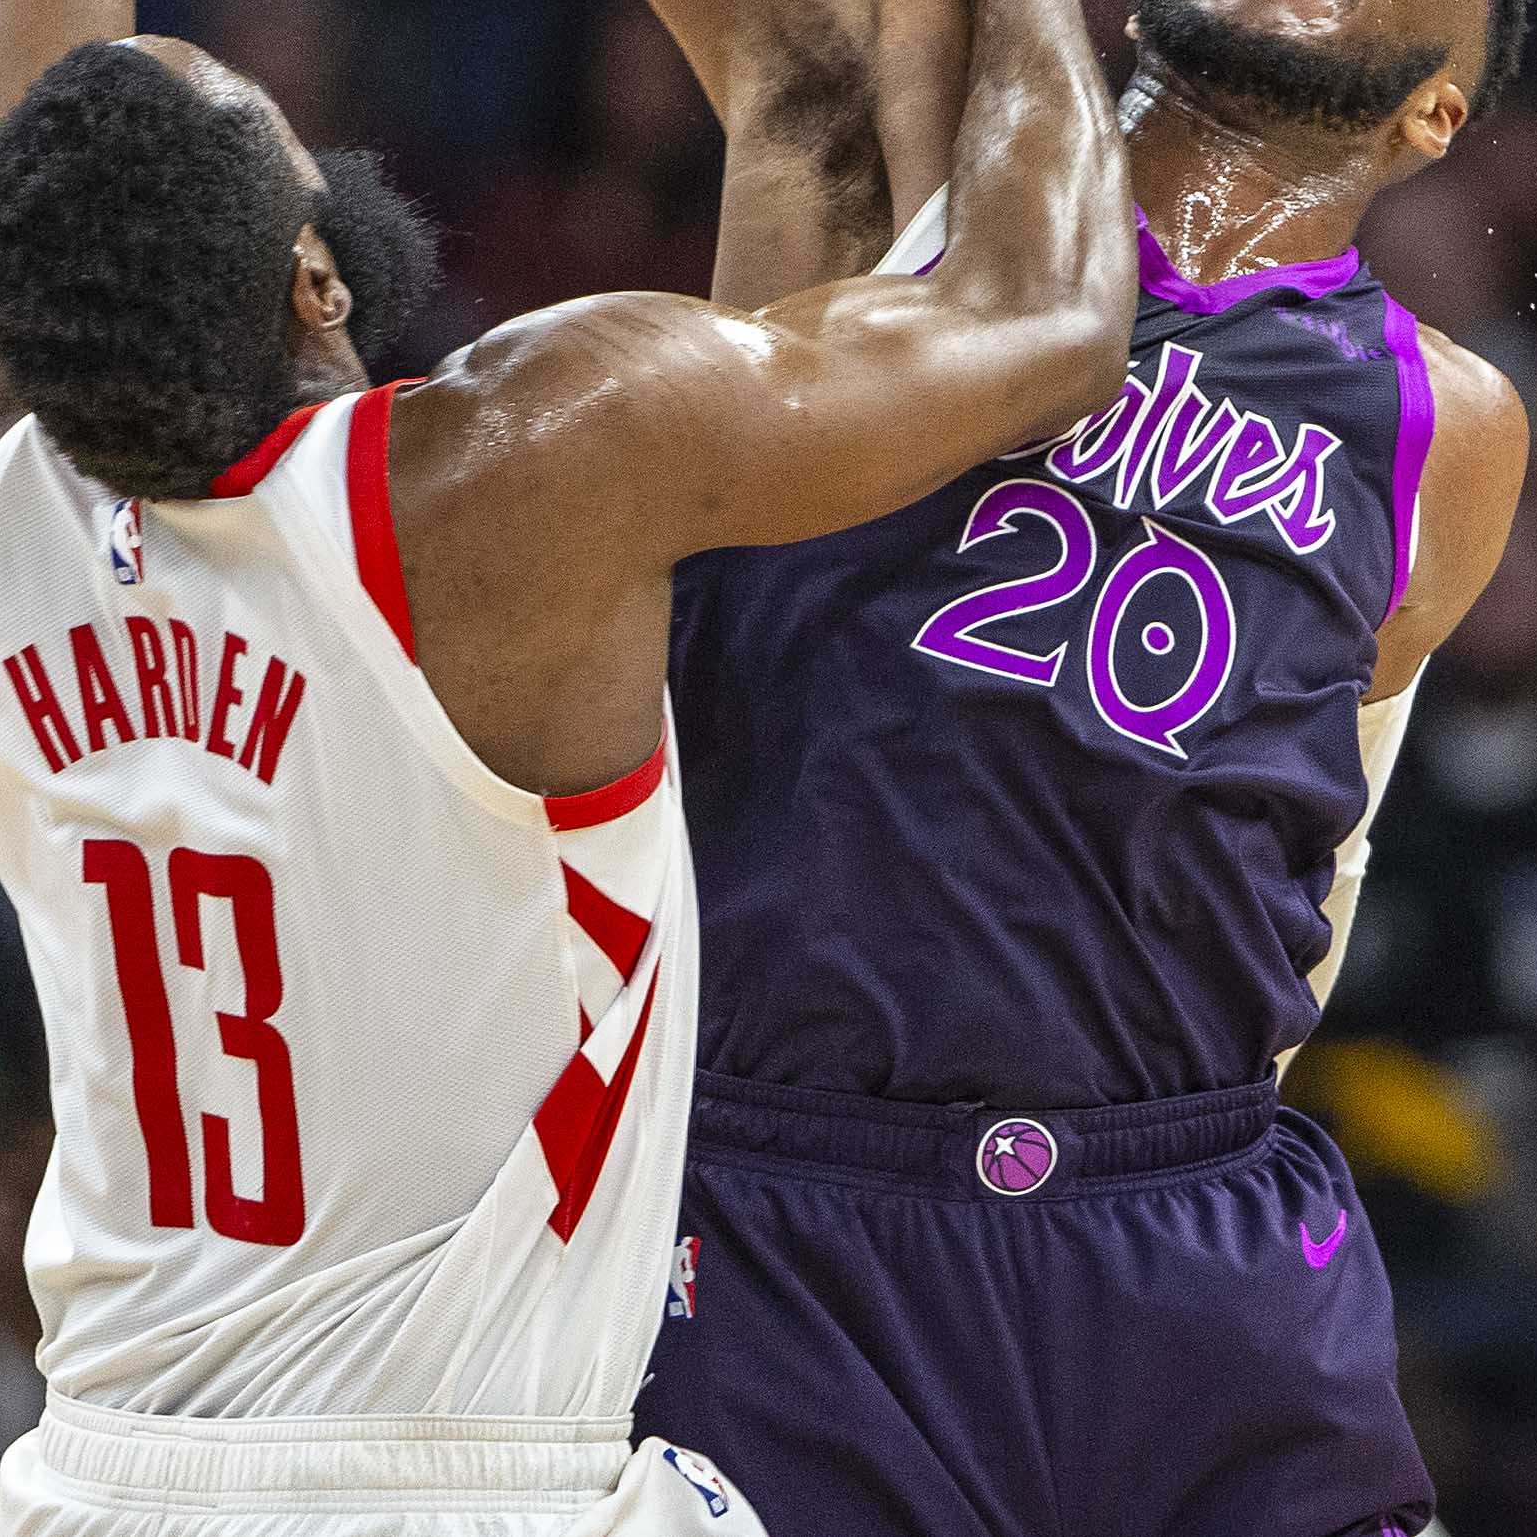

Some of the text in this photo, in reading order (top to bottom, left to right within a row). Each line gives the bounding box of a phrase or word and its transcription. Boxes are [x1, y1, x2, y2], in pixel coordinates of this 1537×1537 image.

[999, 340, 1344, 555] olves
[3, 615, 306, 785] HARDEN
[911, 478, 1236, 760] 20
[83, 838, 305, 1247] 13
